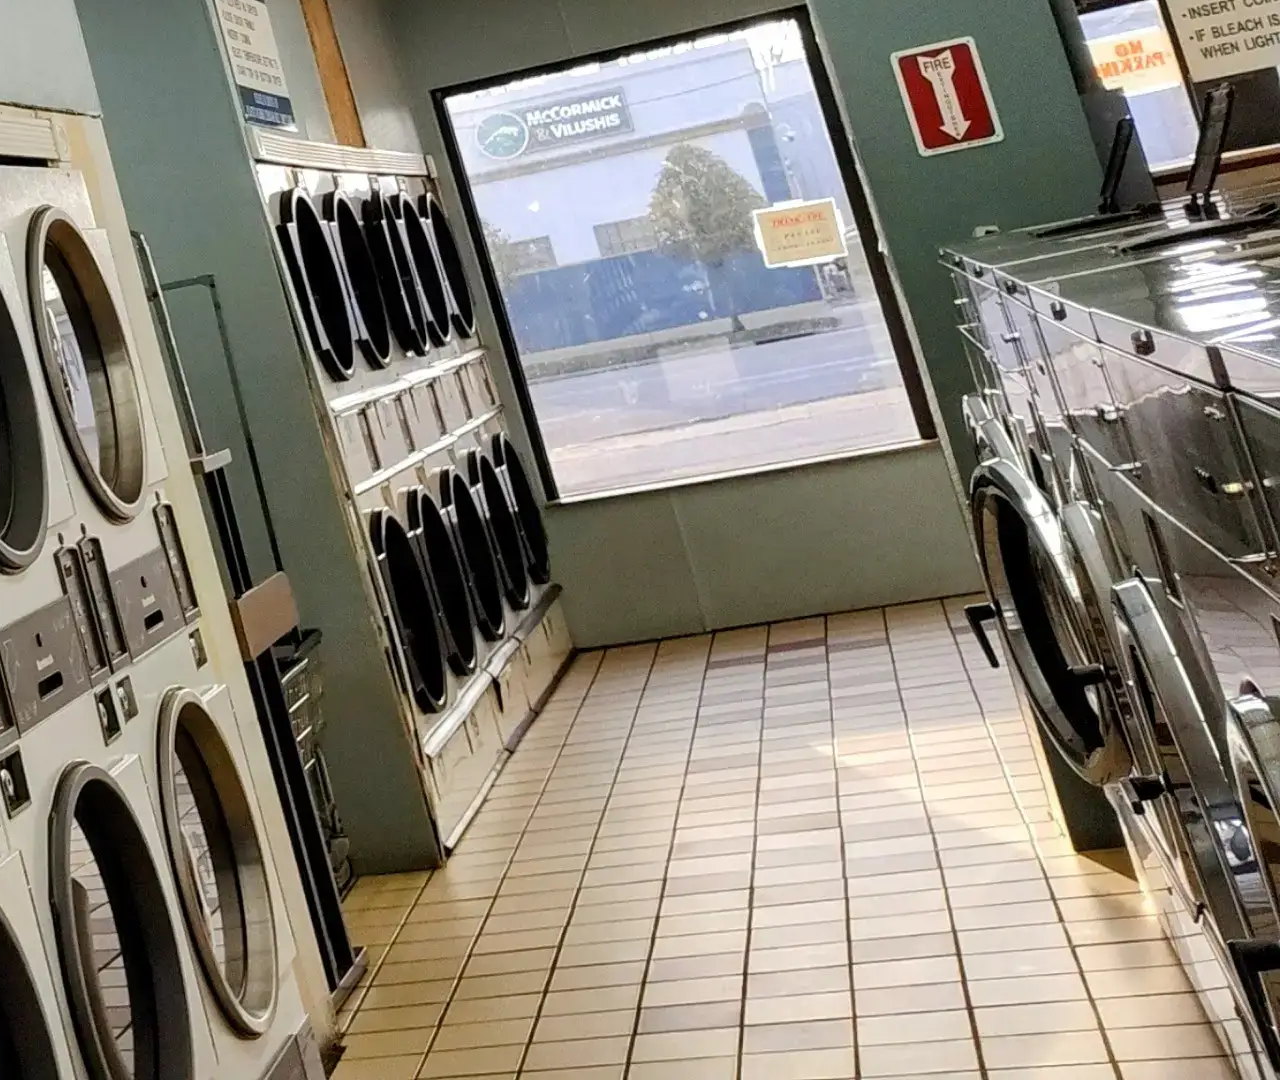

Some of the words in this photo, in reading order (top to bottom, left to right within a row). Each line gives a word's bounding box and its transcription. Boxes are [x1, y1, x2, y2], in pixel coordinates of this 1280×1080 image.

[1195, 29, 1207, 43] IF
[1211, 17, 1265, 39] BLEACH
[1200, 42, 1241, 60] WHEN
[923, 57, 951, 73] FIRE
[536, 128, 550, 141] &
[550, 113, 621, 138] VILUSHIS
